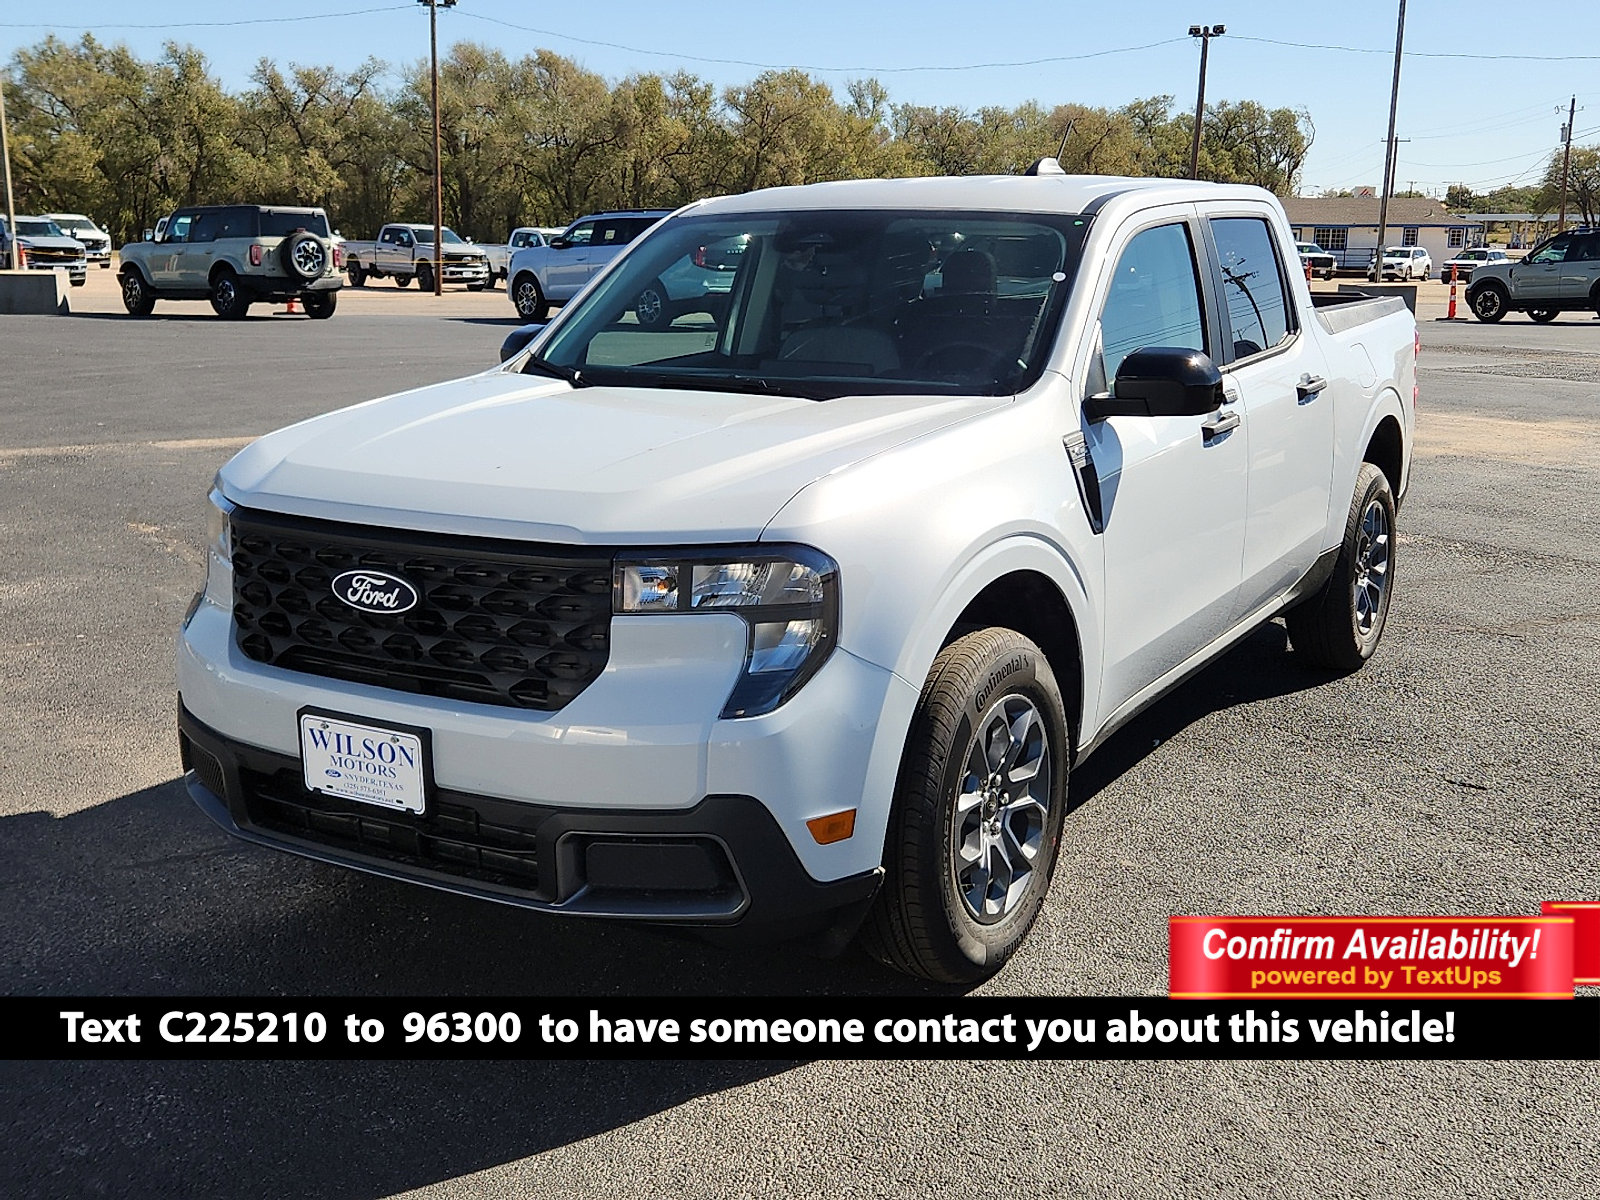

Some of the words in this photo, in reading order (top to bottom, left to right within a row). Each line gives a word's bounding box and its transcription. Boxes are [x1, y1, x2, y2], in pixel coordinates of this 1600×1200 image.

[347, 575, 400, 608] Ford
[975, 654, 1023, 713] Continental
[308, 728, 414, 769] WILSON
[330, 754, 397, 779] MOTORS
